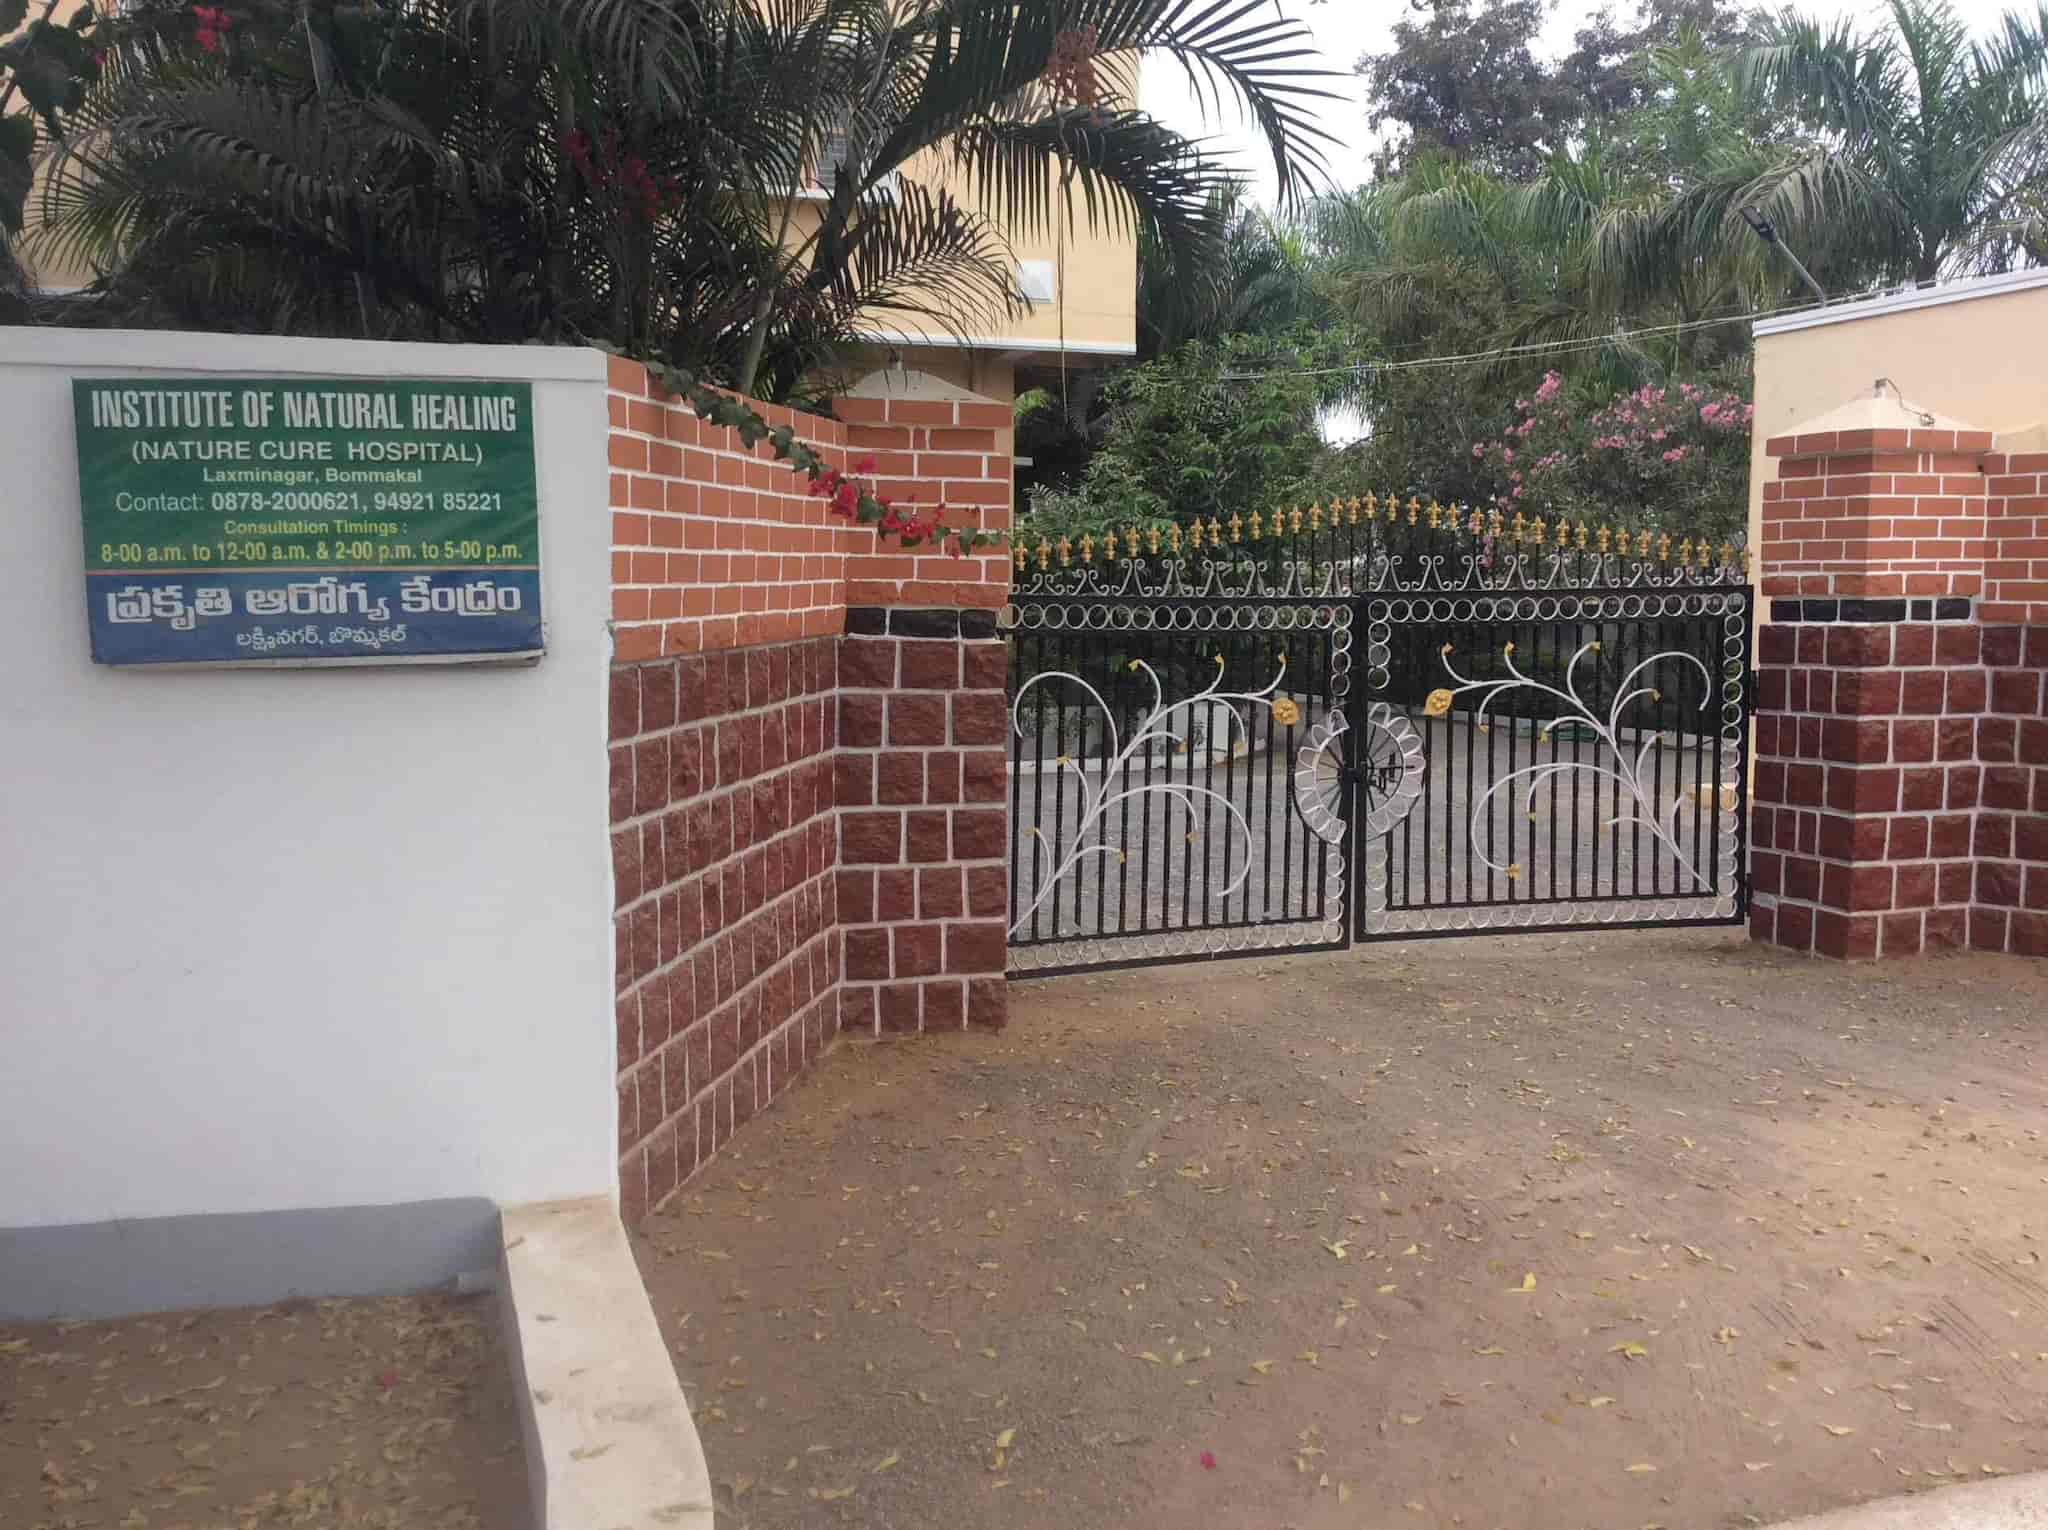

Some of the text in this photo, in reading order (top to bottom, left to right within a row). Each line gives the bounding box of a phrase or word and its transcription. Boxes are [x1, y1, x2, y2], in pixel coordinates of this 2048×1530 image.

[92, 389, 517, 432] INSTITUTE OF NATURAL HEALING
[132, 440, 483, 466] (NATURE CURE HOSPITAL)
[203, 467, 422, 485] Laxminagar, Bommakal
[115, 492, 502, 513] Contact: 0878-2000621, 94921 85221
[224, 520, 329, 534] Consultation
[101, 541, 523, 563] 8-00 a.m. to 12-00 a.m. & 2-00 p.m. to 5-00 p.m.
[107, 575, 521, 630] ప్రకృతి ఆరోగ్య కేంద్రం
